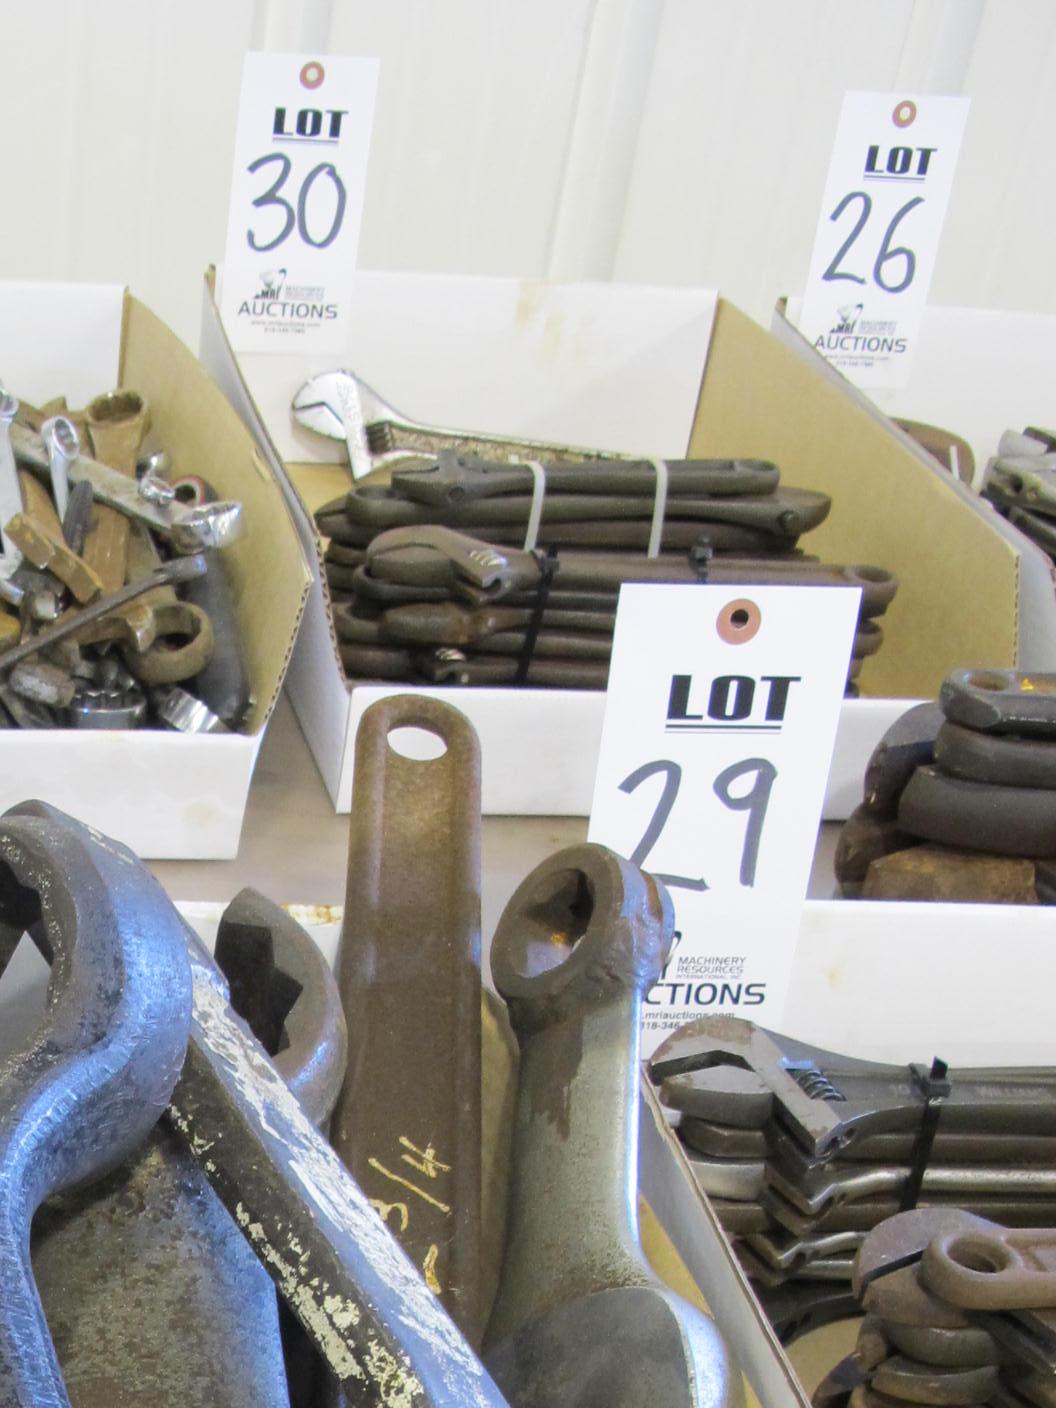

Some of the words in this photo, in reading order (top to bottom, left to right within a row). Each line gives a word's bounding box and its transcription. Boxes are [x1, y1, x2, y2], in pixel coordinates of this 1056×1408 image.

[272, 107, 349, 139] LOT
[864, 145, 938, 176] LOT
[247, 152, 347, 252] 30
[822, 191, 926, 294] 26
[238, 300, 338, 319] AUCTIONS
[815, 335, 907, 353] AUCTIONS
[666, 674, 802, 722] LOT
[618, 757, 778, 892] 29
[676, 965, 744, 974] RESOURCES
[678, 956, 746, 966] MACHINERY
[644, 983, 767, 1005] CTIONS
